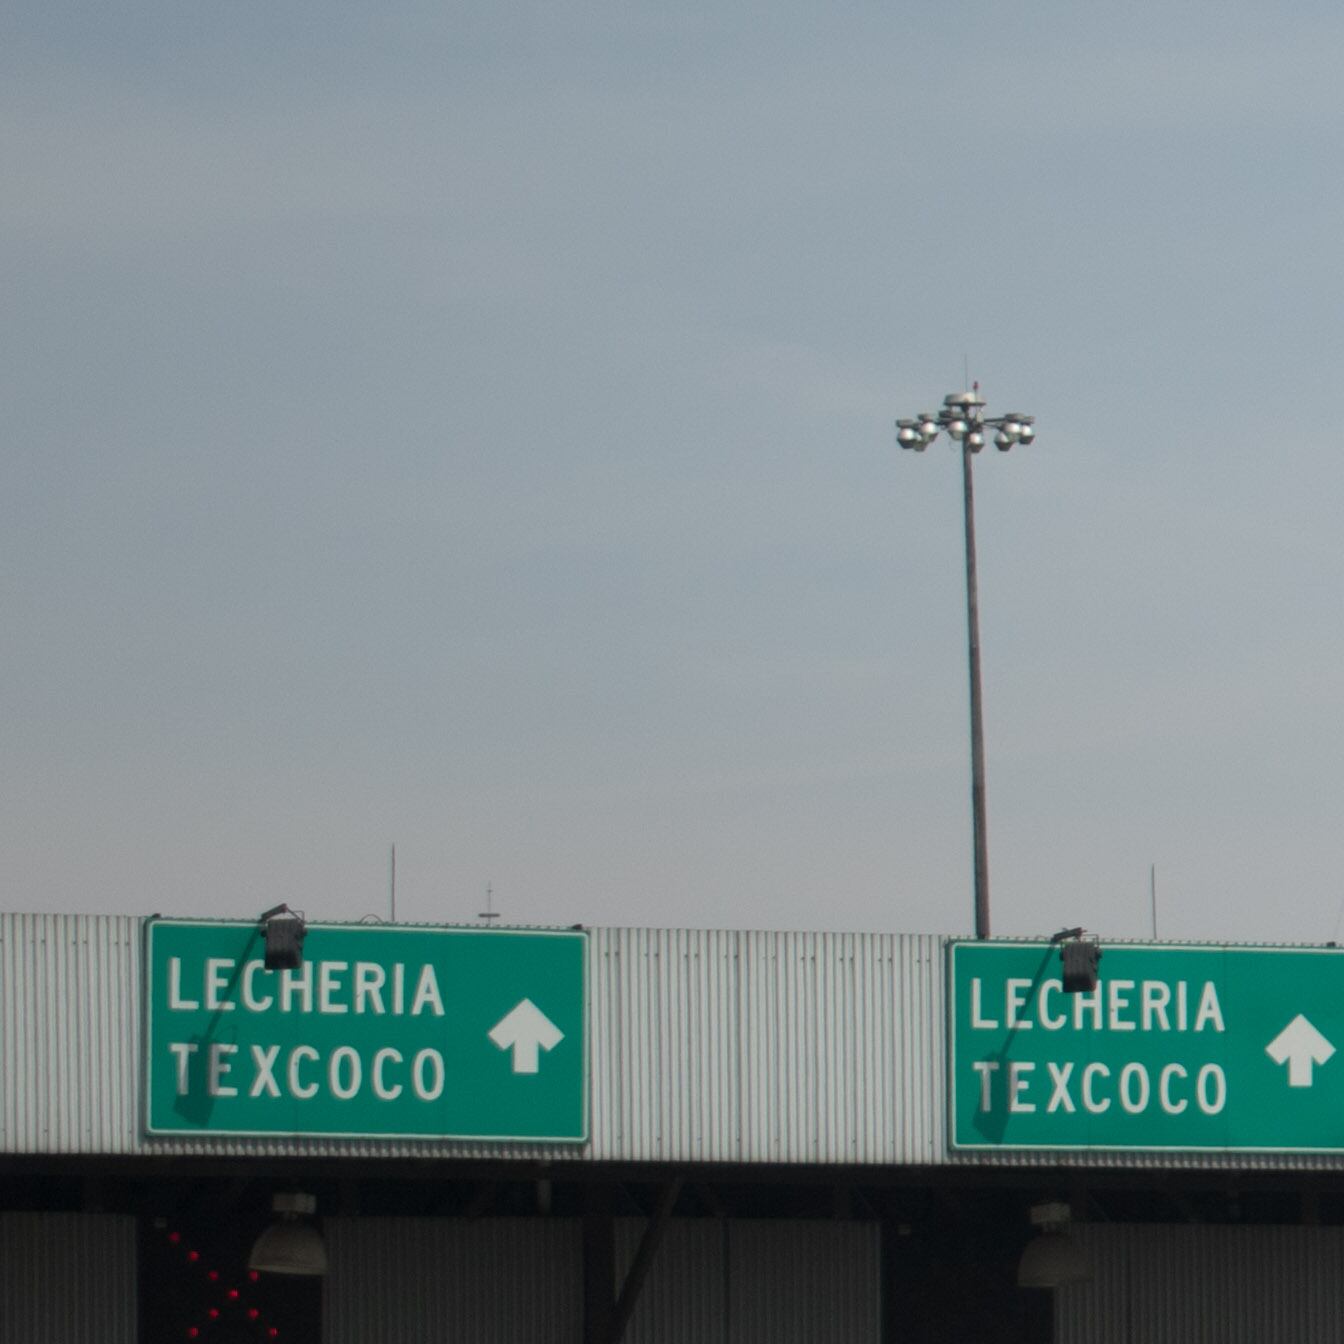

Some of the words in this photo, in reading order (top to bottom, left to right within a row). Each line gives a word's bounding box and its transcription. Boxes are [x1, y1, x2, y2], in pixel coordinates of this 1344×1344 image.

[168, 957, 445, 1016] LECHERIA
[970, 977, 1226, 1032] LECHERIA
[169, 1043, 446, 1101] TEXCOCO
[972, 1061, 1227, 1115] TEXCOCO
